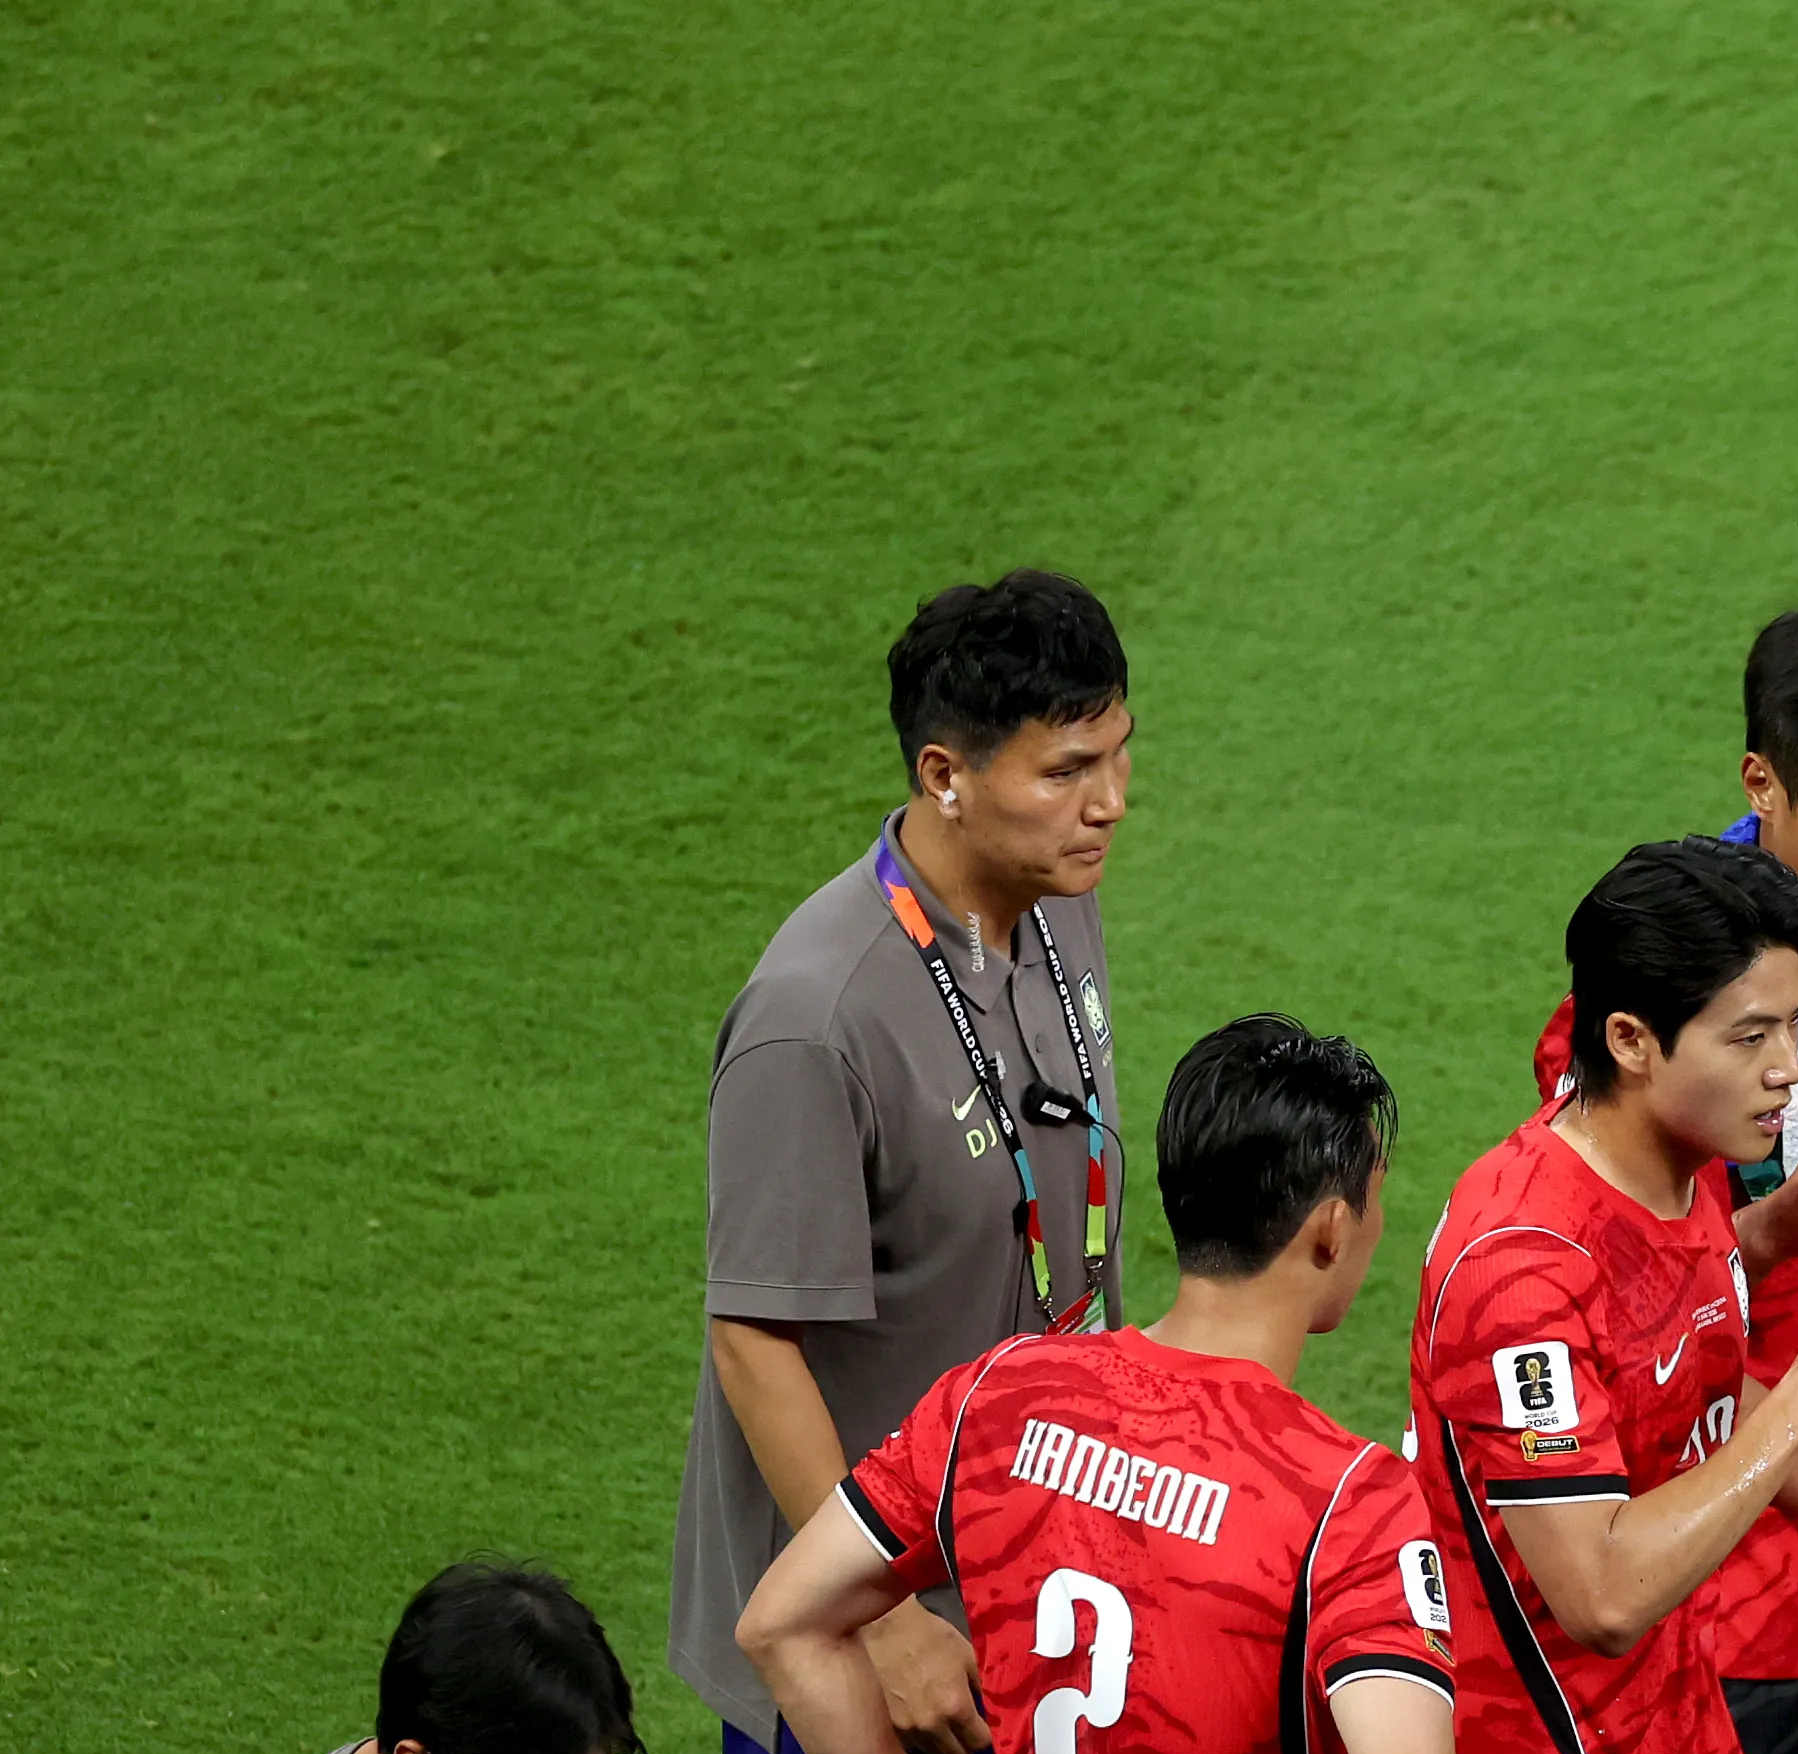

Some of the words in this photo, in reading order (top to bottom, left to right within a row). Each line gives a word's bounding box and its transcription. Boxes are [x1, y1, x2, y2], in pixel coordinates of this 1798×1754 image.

[1033, 902, 1054, 948] 202
[1048, 949, 1063, 982] CUP
[930, 958, 954, 995] FIFA
[947, 991, 976, 1049] WORLD
[1059, 983, 1082, 1043] WORLD
[1076, 1046, 1092, 1080] FIFA
[965, 1118, 998, 1159] DJ
[1529, 1397, 1548, 1408] FIFA
[1525, 1416, 1560, 1429] 2026
[1536, 1438, 1574, 1449] DEBUT
[1008, 1417, 1232, 1546] HANBEOM
